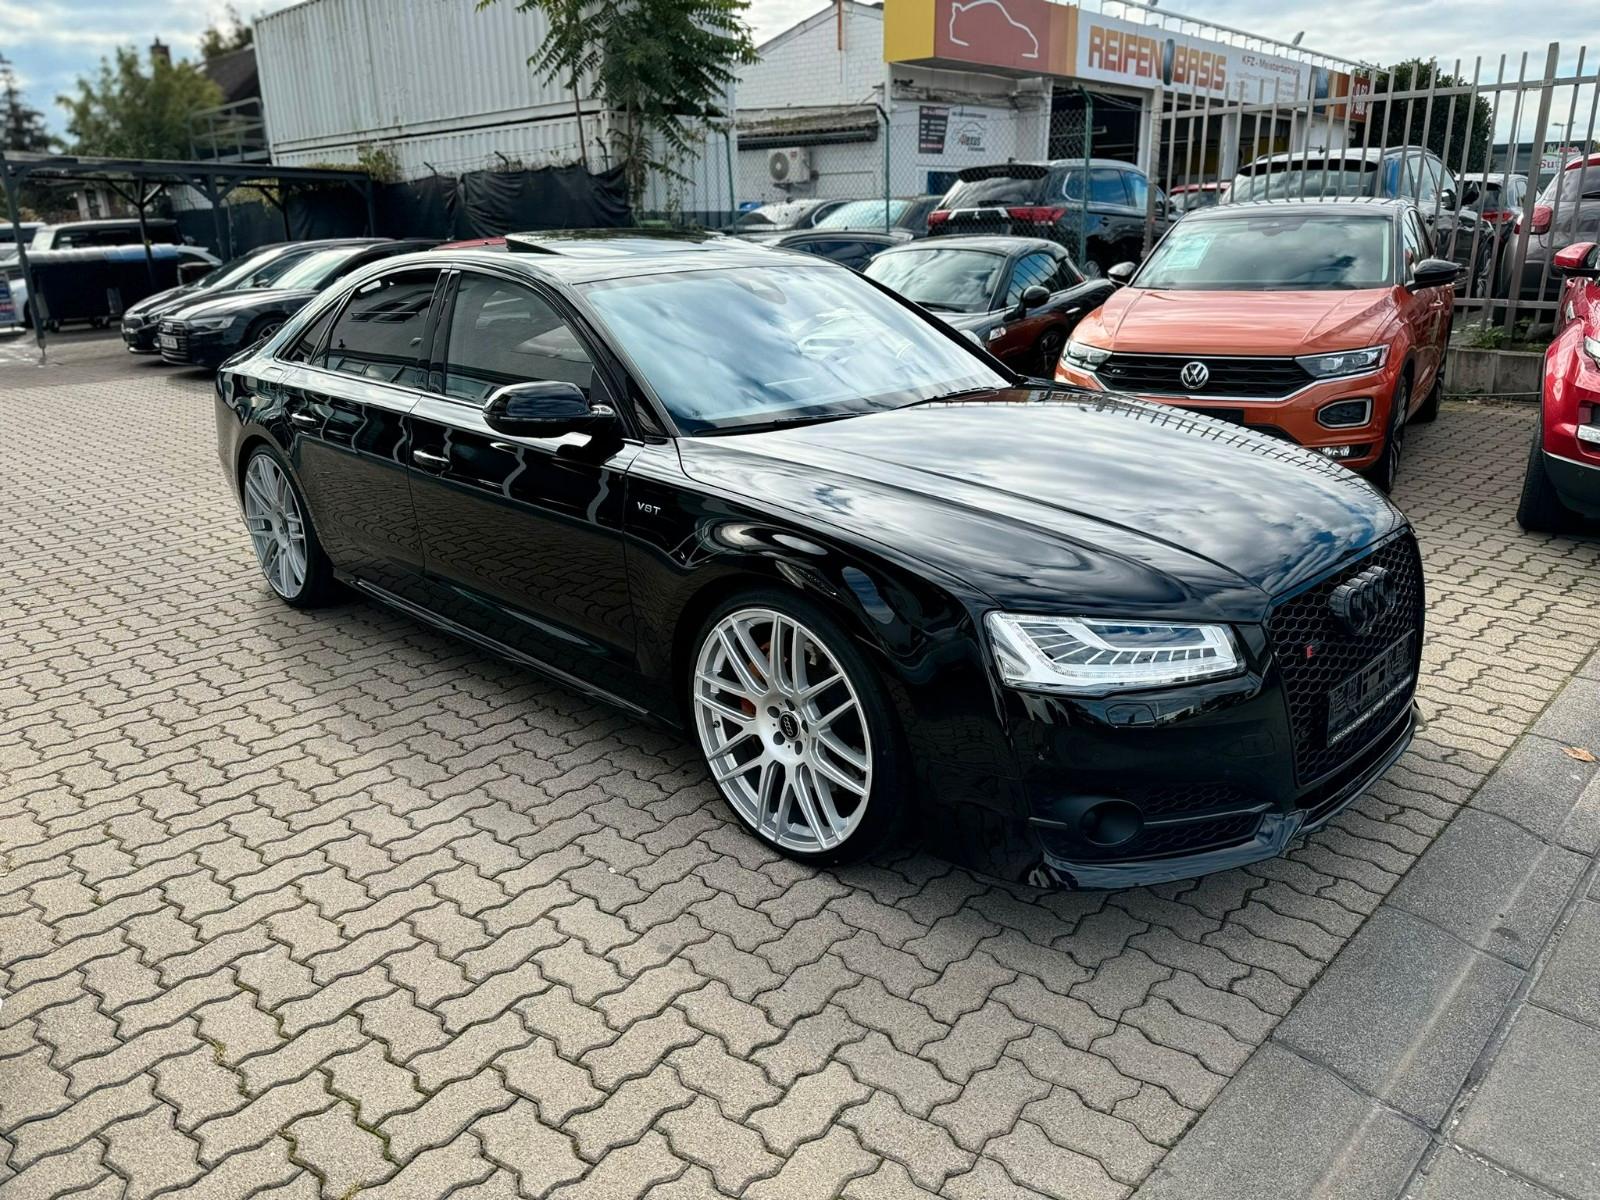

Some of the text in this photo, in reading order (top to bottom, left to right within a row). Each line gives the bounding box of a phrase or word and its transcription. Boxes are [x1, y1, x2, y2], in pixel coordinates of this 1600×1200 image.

[1088, 25, 1227, 91] REIFEN BASIS
[637, 501, 661, 515] V8T
